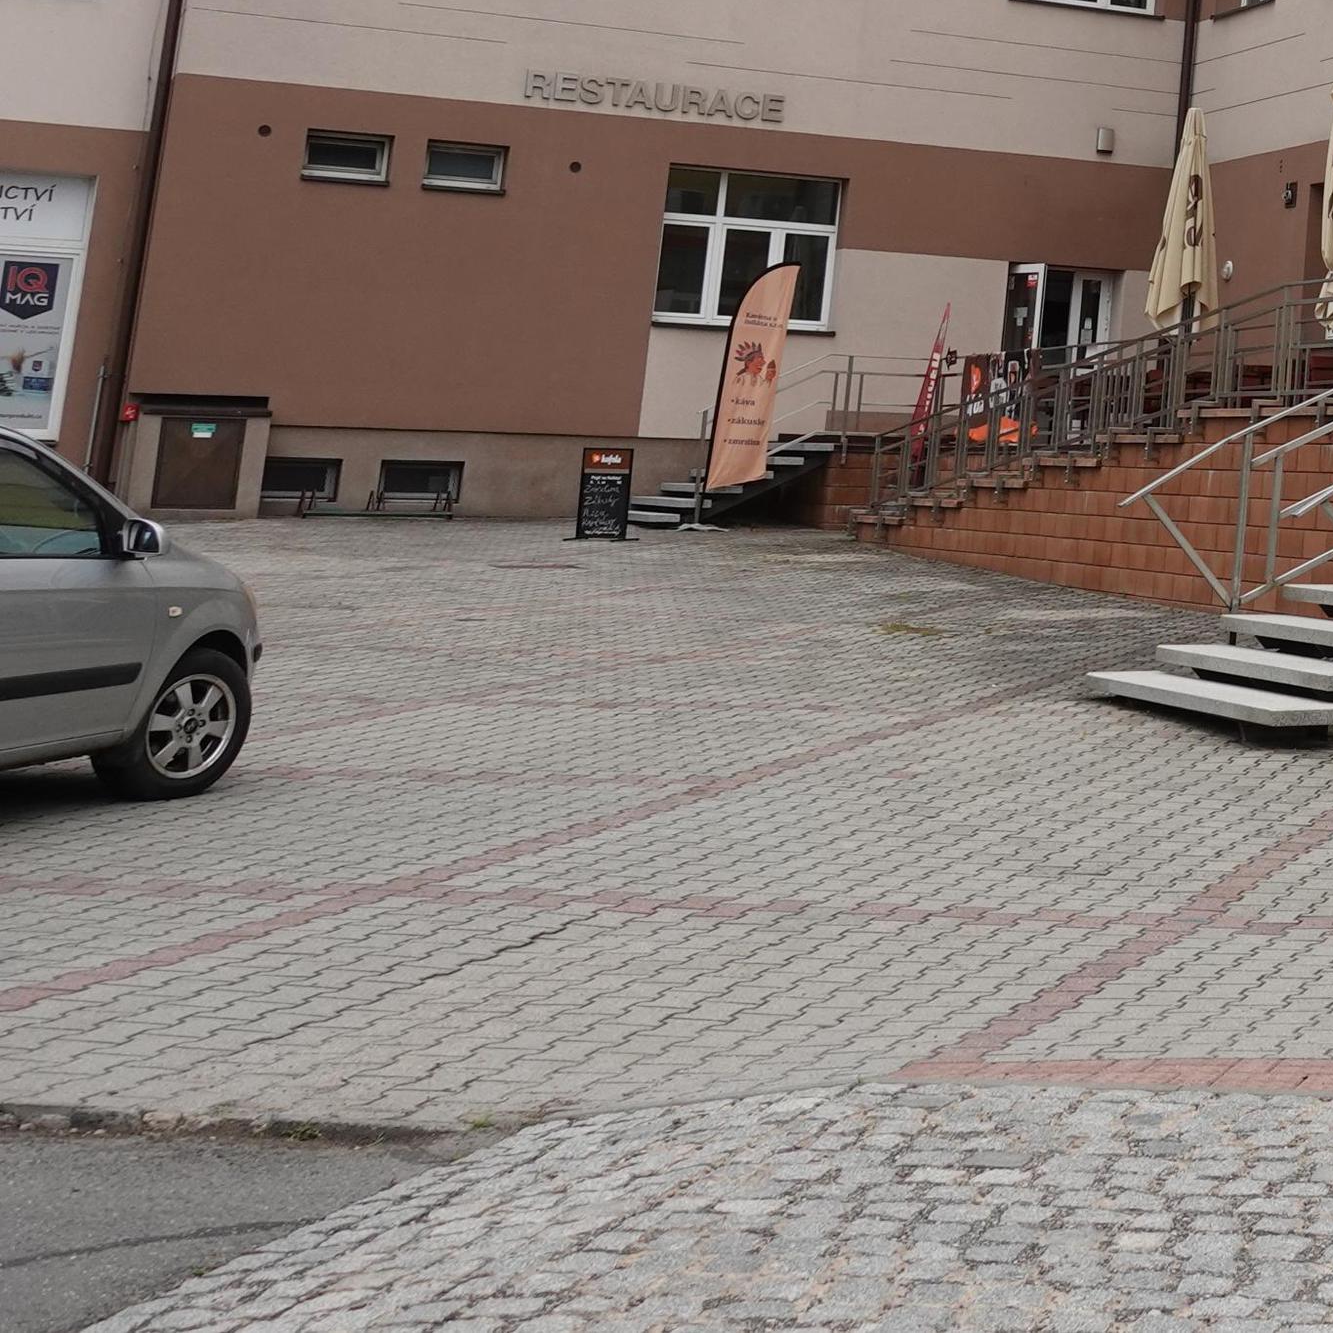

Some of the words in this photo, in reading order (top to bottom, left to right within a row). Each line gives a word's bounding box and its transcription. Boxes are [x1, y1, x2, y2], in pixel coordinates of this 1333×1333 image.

[524, 69, 785, 123] RESTAURACE
[7, 265, 49, 293] IQ
[5, 291, 49, 306] MAG
